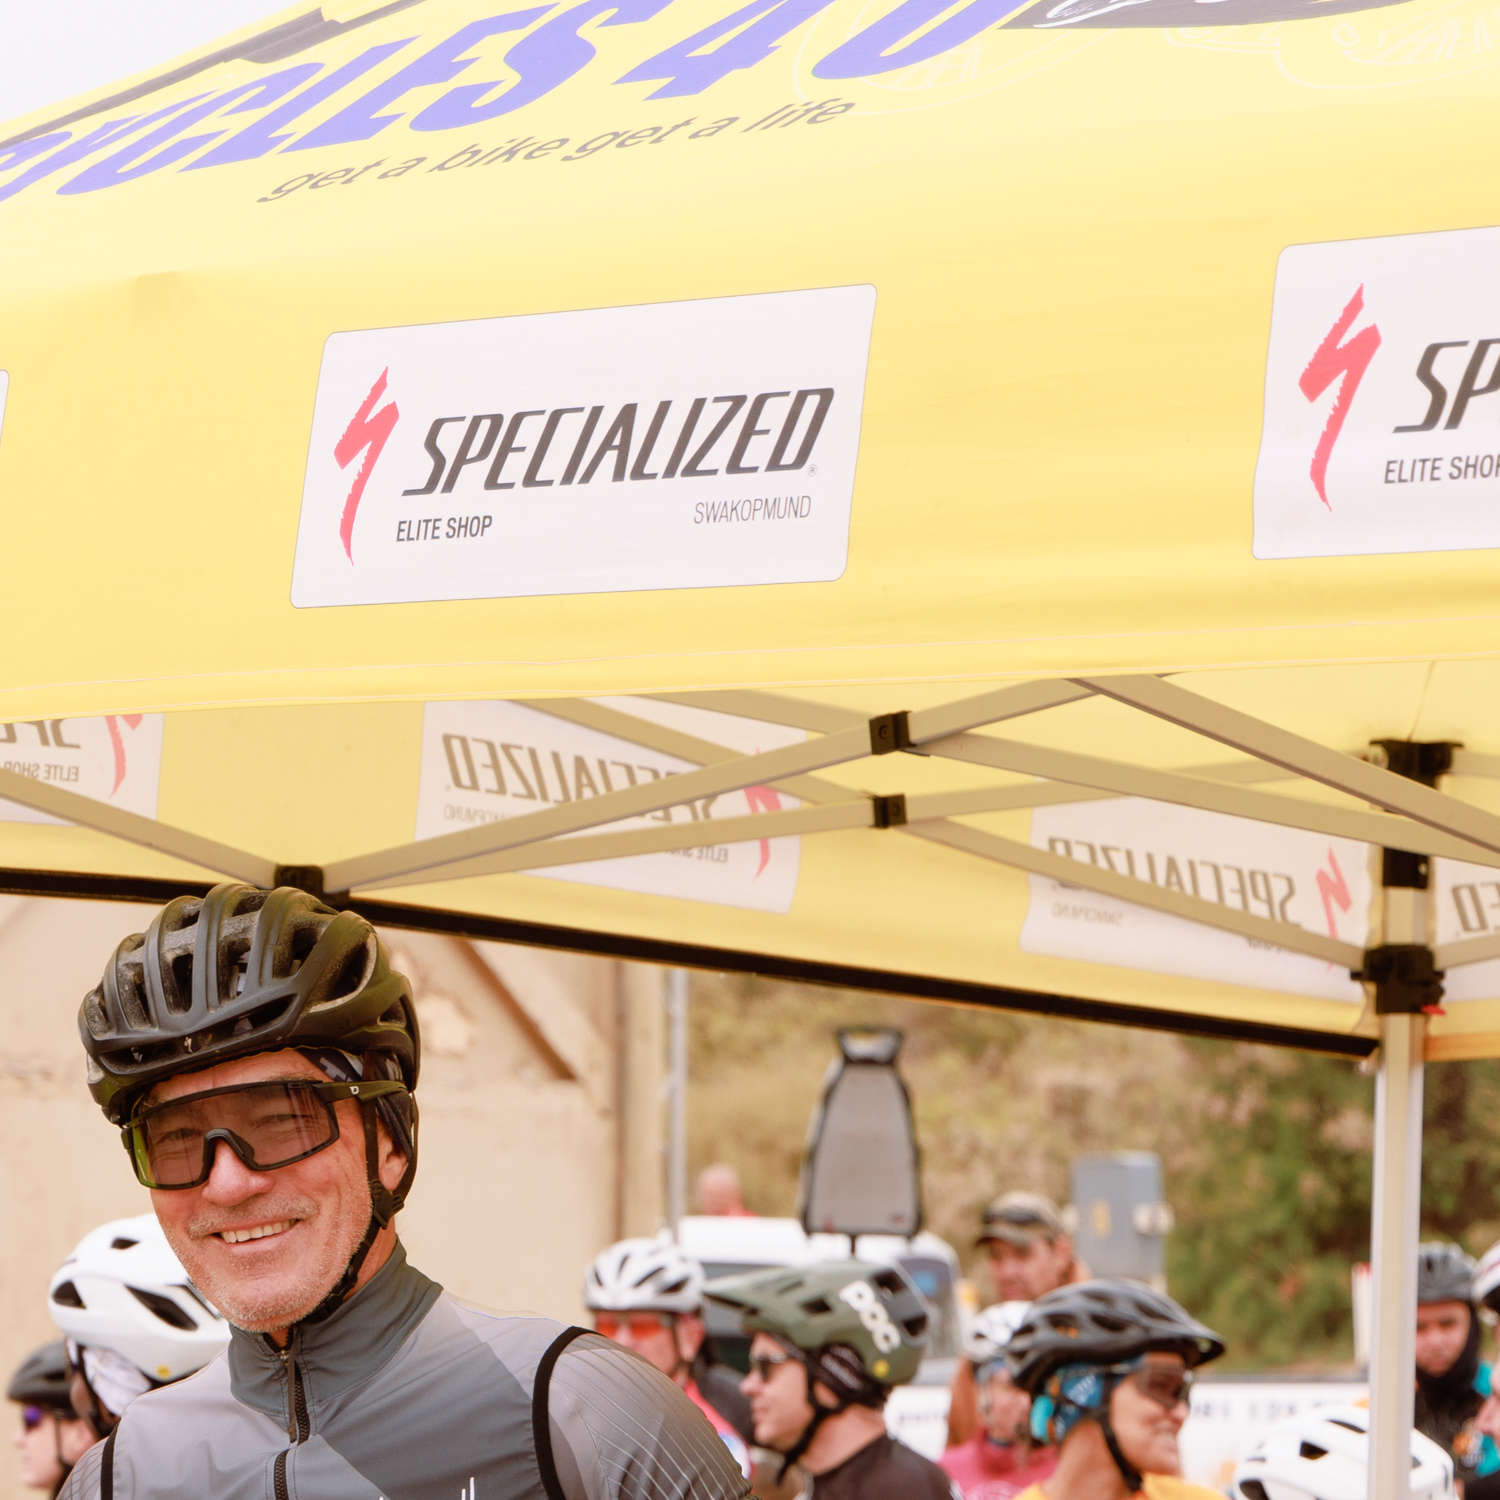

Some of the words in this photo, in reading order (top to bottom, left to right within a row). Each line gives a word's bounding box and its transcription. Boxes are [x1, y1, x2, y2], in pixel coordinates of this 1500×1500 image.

[257, 155, 391, 203] get
[376, 155, 428, 180] a
[426, 137, 569, 174] bike
[560, 116, 700, 162] get
[688, 115, 741, 140] a
[740, 97, 856, 133] life
[401, 387, 835, 497] SPECIALIZED
[1384, 457, 1443, 484] ELITE
[396, 518, 441, 543] ELITE
[444, 515, 494, 539] SHOP
[693, 495, 812, 526] SWAKOPMUND
[839, 1280, 902, 1354] POC
